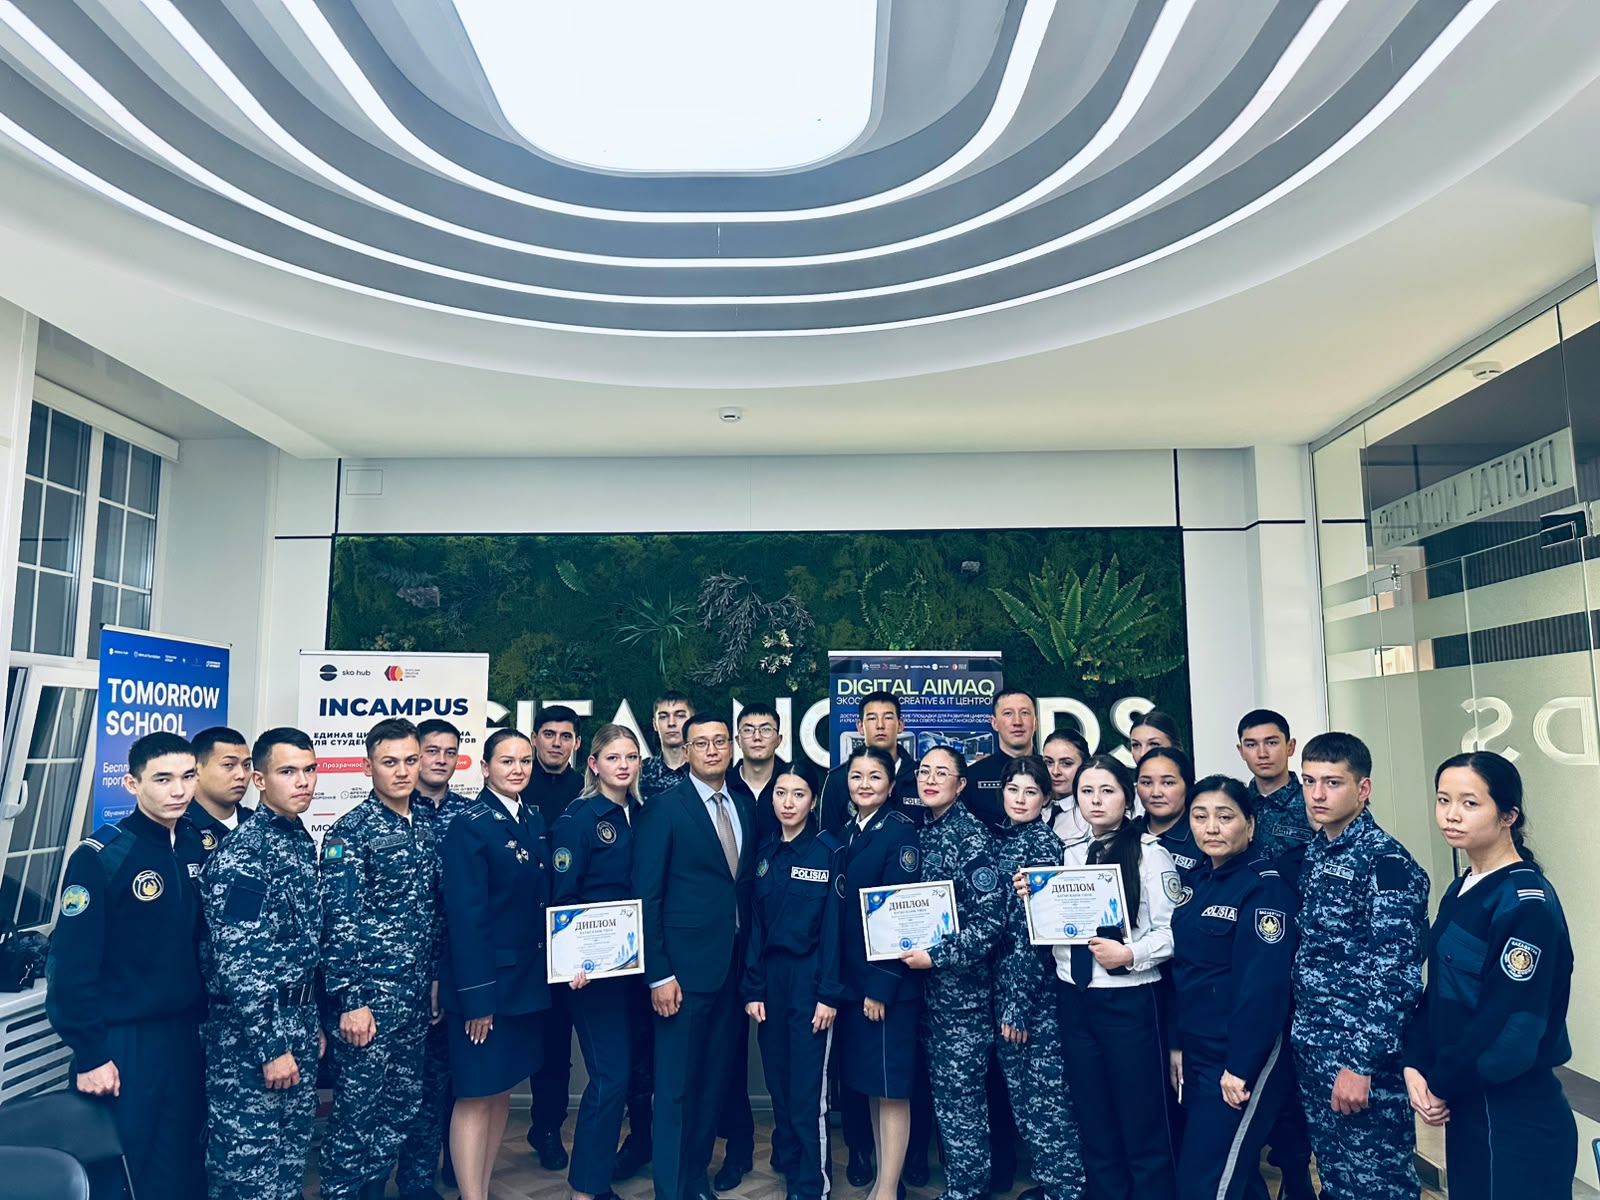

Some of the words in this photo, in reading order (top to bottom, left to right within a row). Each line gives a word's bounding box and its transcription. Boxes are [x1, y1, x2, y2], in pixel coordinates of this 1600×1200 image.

[356, 668, 371, 676] hub
[107, 677, 220, 709] TOMORROW
[837, 679, 919, 696] DIGITAL
[922, 679, 995, 696] AIMAQ
[319, 697, 469, 717] INCAMPUS
[899, 697, 937, 705] CREATIVE
[938, 697, 945, 705] &
[946, 697, 955, 705] IT
[955, 697, 993, 706] ЦЕНТРО
[105, 710, 187, 737] SCHOOL
[792, 868, 828, 880] POLISIA
[1051, 883, 1095, 894] ДИПЛОМ
[889, 898, 930, 912] ДИПЛОМ
[575, 918, 617, 932] ДИПЛОМ
